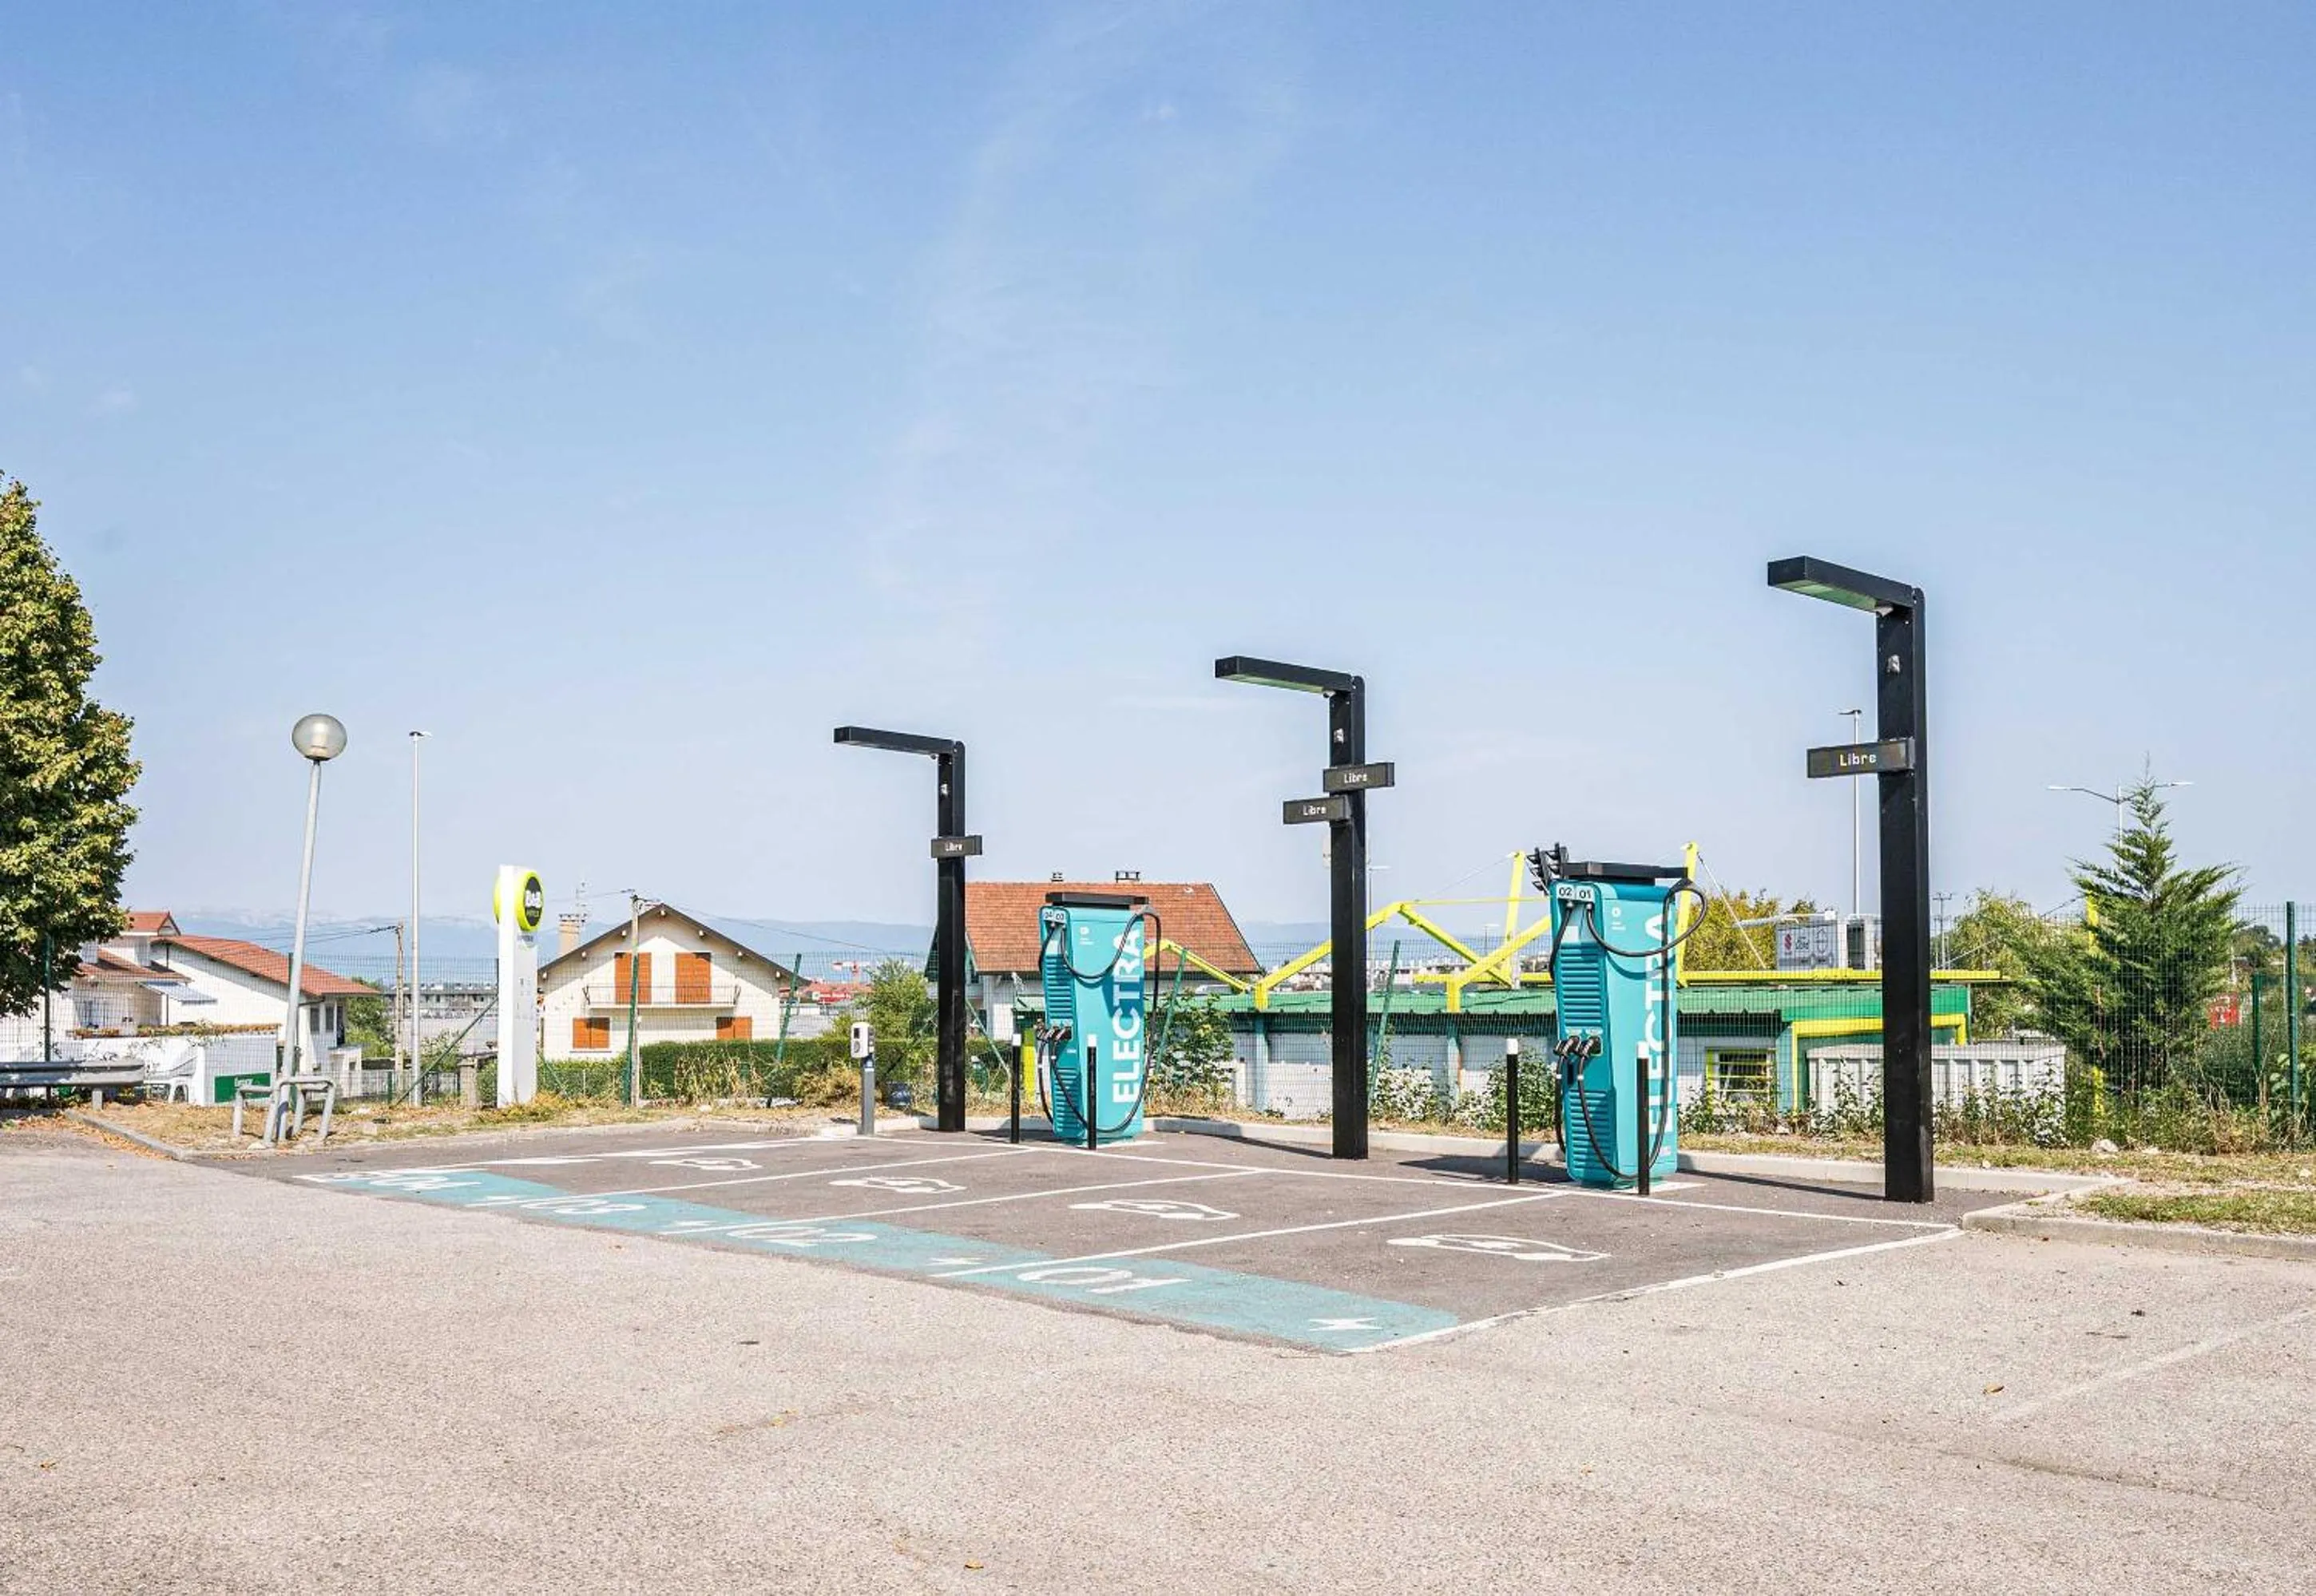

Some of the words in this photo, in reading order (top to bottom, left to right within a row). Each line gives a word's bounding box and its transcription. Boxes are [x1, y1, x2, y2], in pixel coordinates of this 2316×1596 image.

[1839, 752, 1877, 766] Libre
[1343, 772, 1368, 784] Libre
[1303, 805, 1327, 816] Libre
[1559, 887, 1572, 897] 02
[1579, 889, 1592, 899] 01
[1112, 928, 1141, 1103] ELECTRA
